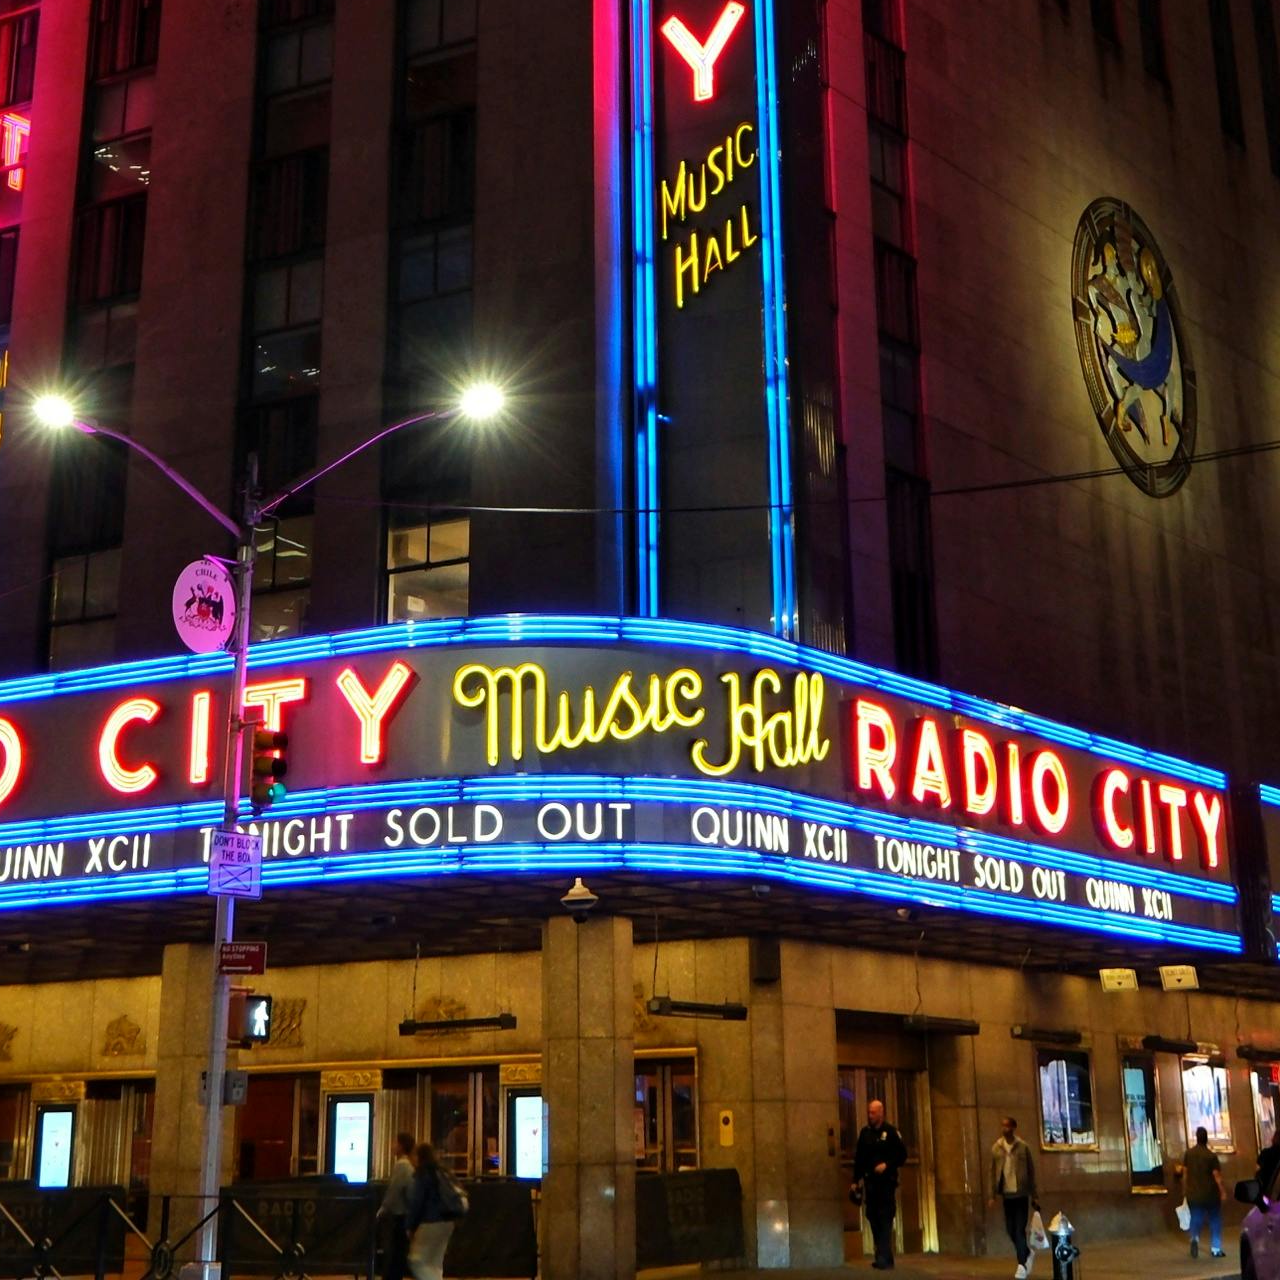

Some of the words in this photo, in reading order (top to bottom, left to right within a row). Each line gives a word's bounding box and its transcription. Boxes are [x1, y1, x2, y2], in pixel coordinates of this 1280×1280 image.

[661, 122, 756, 239] MUSIC
[674, 205, 759, 309] HALL
[195, 568, 218, 581] CHILE
[99, 659, 417, 794] CITY
[692, 668, 830, 776] Hall
[853, 697, 1071, 835] RADIO
[1099, 768, 1222, 870] CITY
[86, 833, 150, 876] XCII
[200, 813, 354, 864] TNIGHT
[384, 805, 503, 847] SOLD
[538, 802, 631, 841] OUT
[692, 807, 789, 854] QUINN
[803, 820, 848, 864] XCII
[875, 836, 960, 885] TONIGHT
[974, 856, 1024, 894] SOLD
[1032, 870, 1067, 902] OUT
[1086, 878, 1136, 914] QUINN
[1142, 888, 1173, 922] XCII
[214, 835, 234, 847] DON'T
[236, 838, 259, 850] BLOCK
[222, 850, 234, 862] THE
[237, 851, 251, 863] BOX
